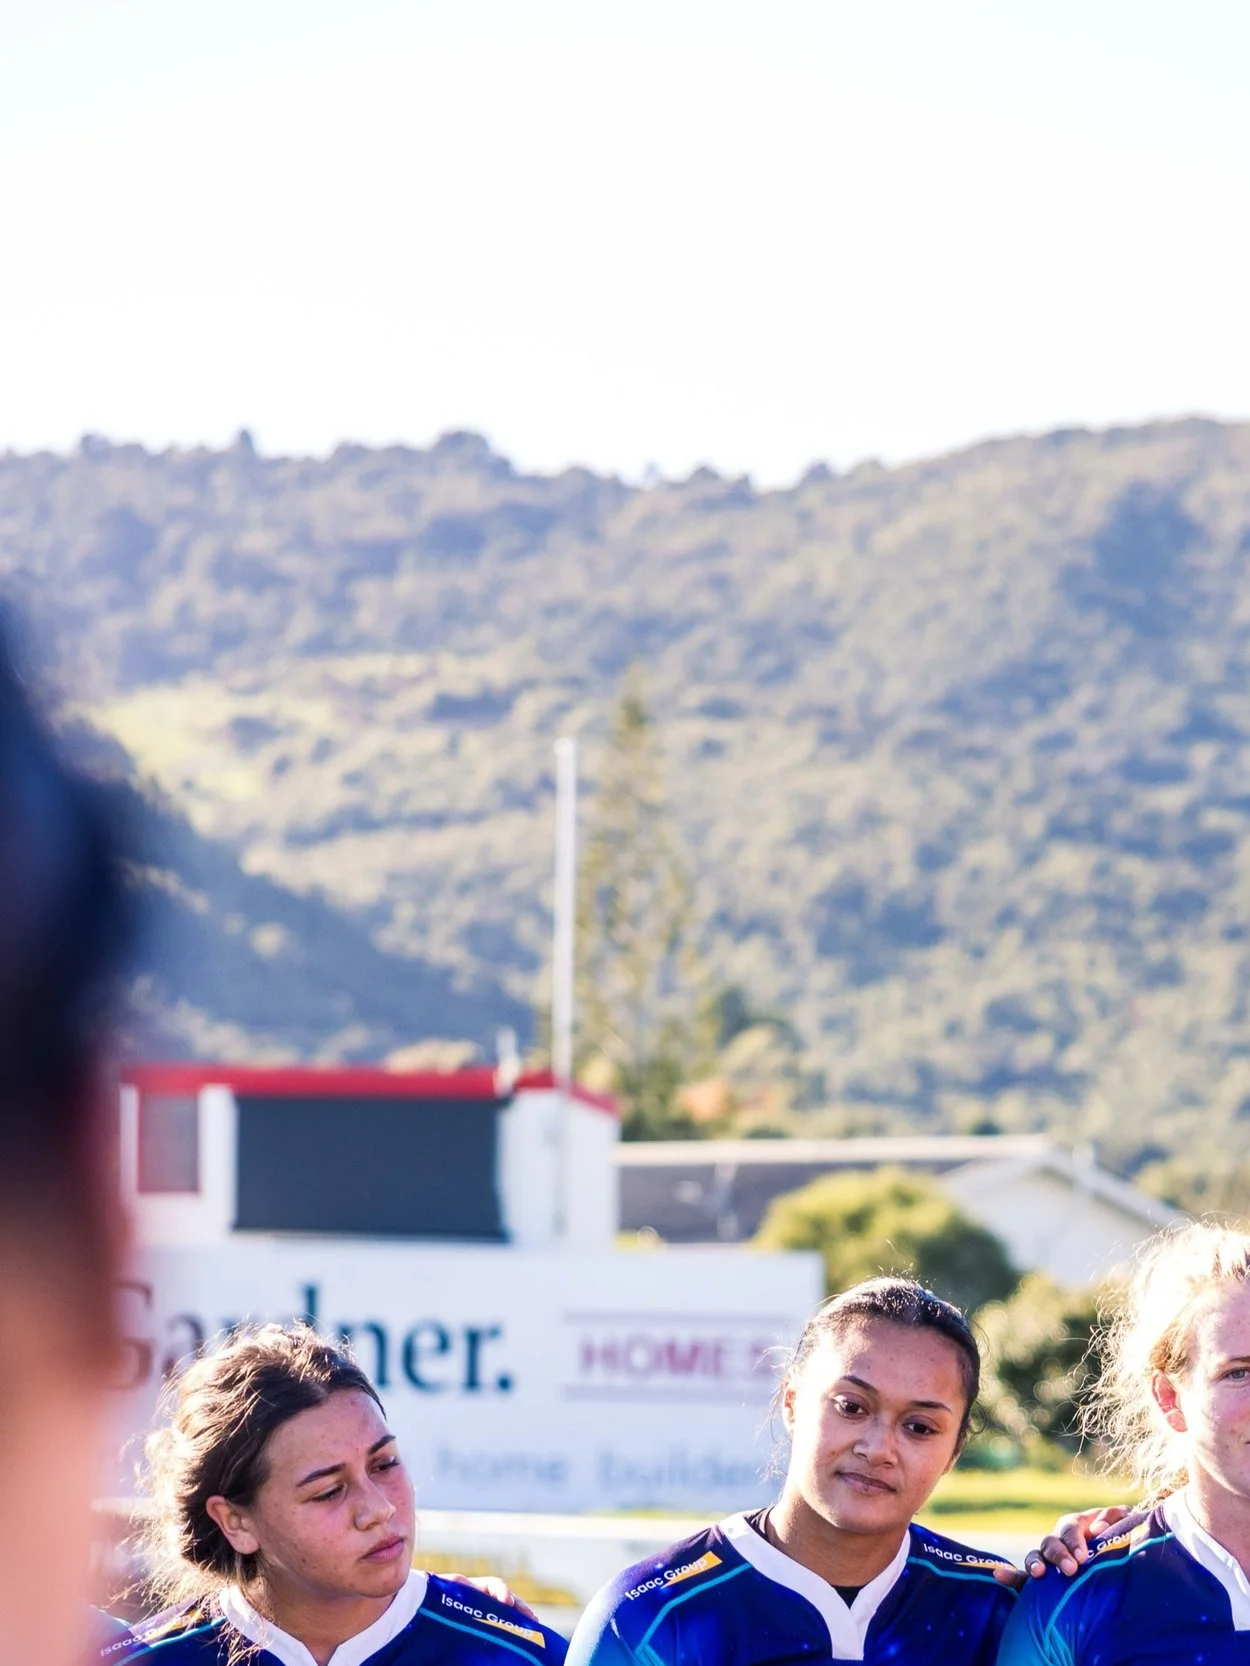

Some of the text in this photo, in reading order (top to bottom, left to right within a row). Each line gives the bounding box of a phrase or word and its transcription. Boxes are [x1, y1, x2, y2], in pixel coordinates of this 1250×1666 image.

[923, 1543, 963, 1562] Isaac
[624, 1558, 708, 1601] Isaac Group
[441, 1593, 533, 1638] Isaac Group
